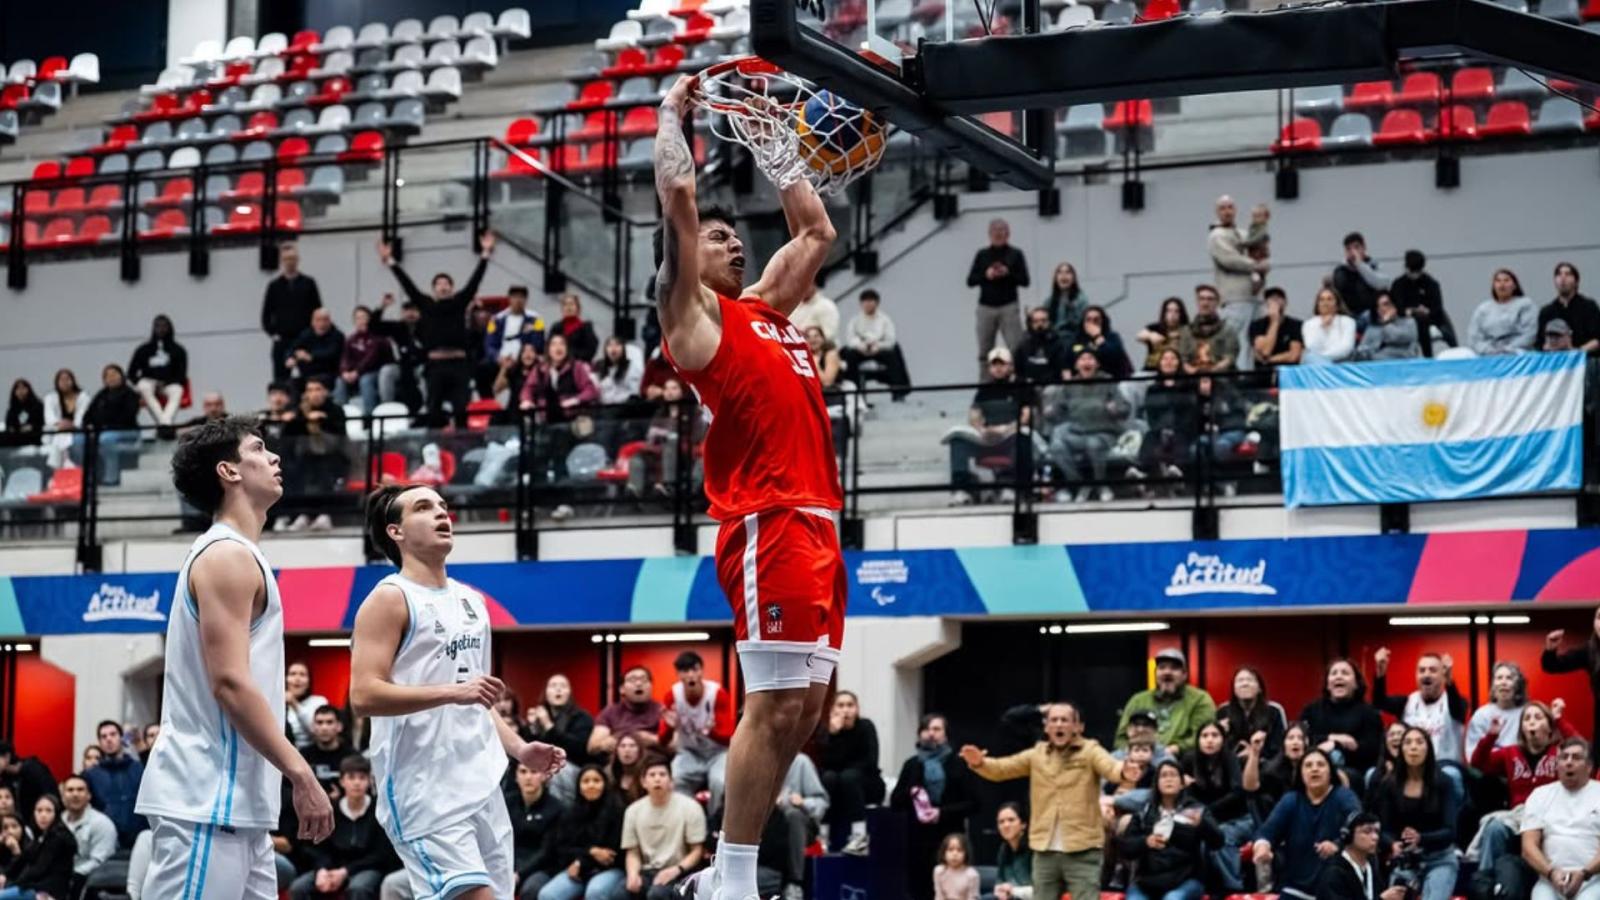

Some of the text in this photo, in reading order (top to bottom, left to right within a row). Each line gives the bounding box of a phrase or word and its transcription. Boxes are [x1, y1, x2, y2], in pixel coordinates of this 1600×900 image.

[750, 321, 806, 343] CHIL
[782, 347, 815, 378] 15
[1171, 558, 1266, 585] Actitud
[87, 588, 160, 612] Actitud
